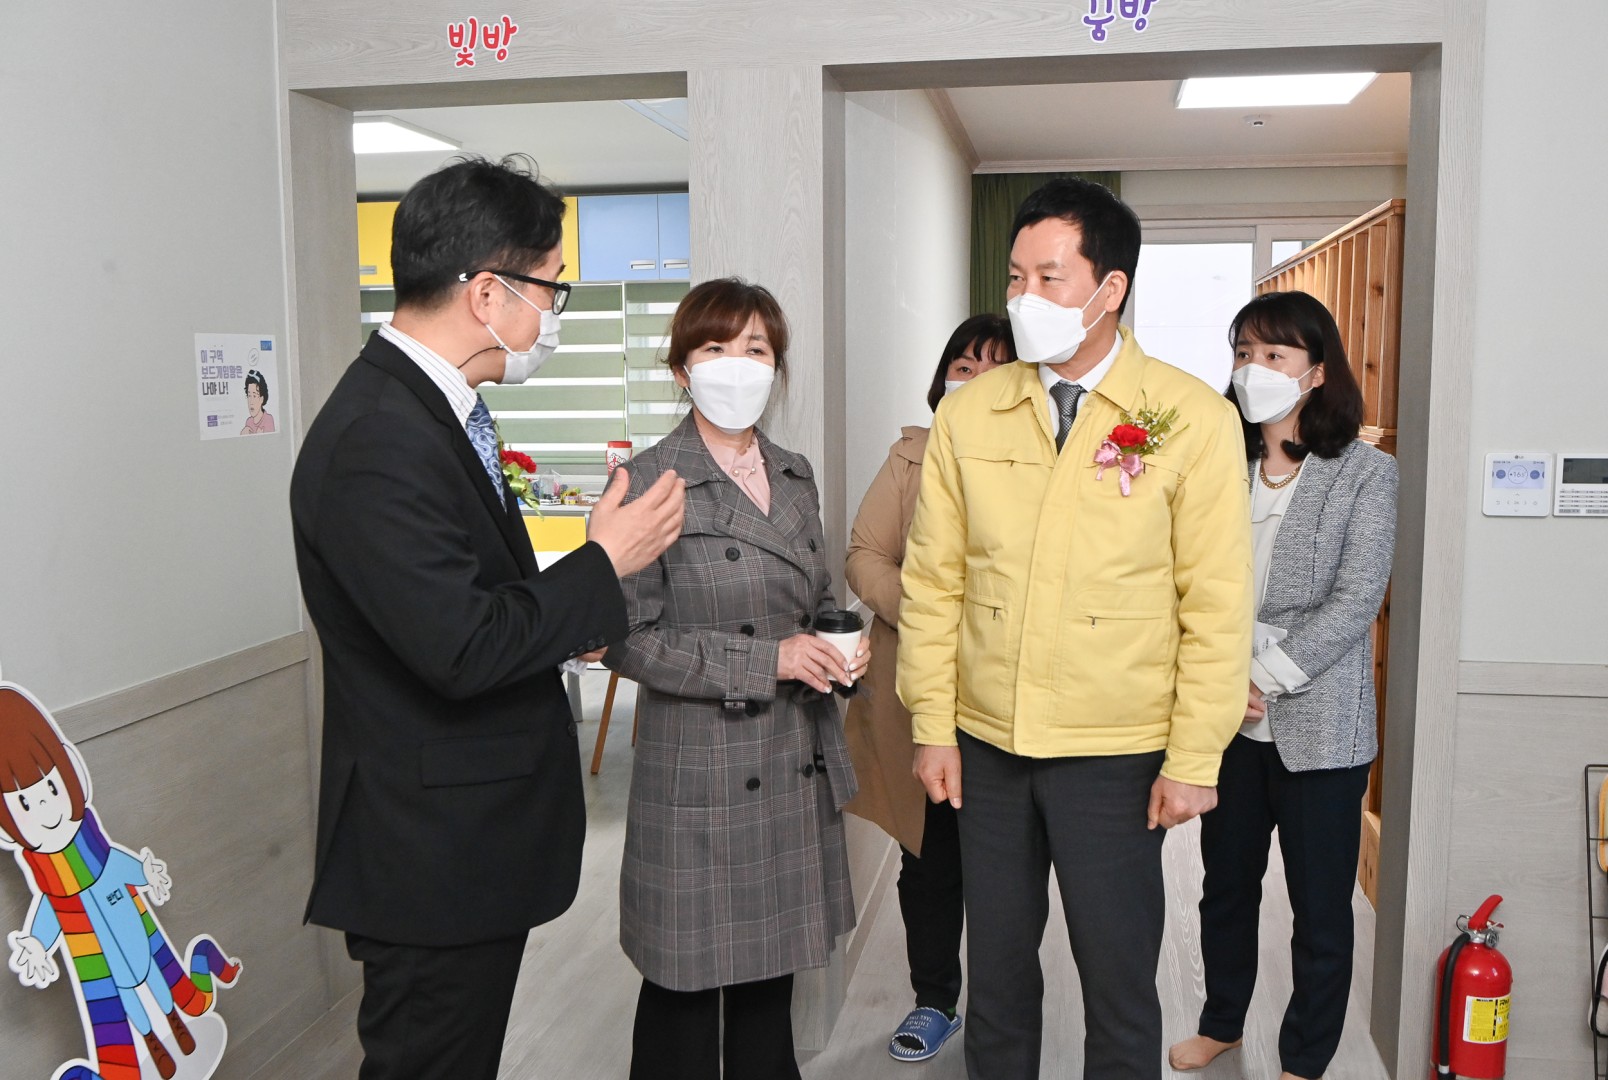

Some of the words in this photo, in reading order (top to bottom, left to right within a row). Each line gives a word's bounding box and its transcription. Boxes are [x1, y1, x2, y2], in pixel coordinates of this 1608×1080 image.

[448, 16, 518, 67] 빛방
[200, 349, 208, 364] 이
[209, 349, 224, 364] 구역
[202, 381, 217, 396] 나야
[218, 381, 229, 395] 나!
